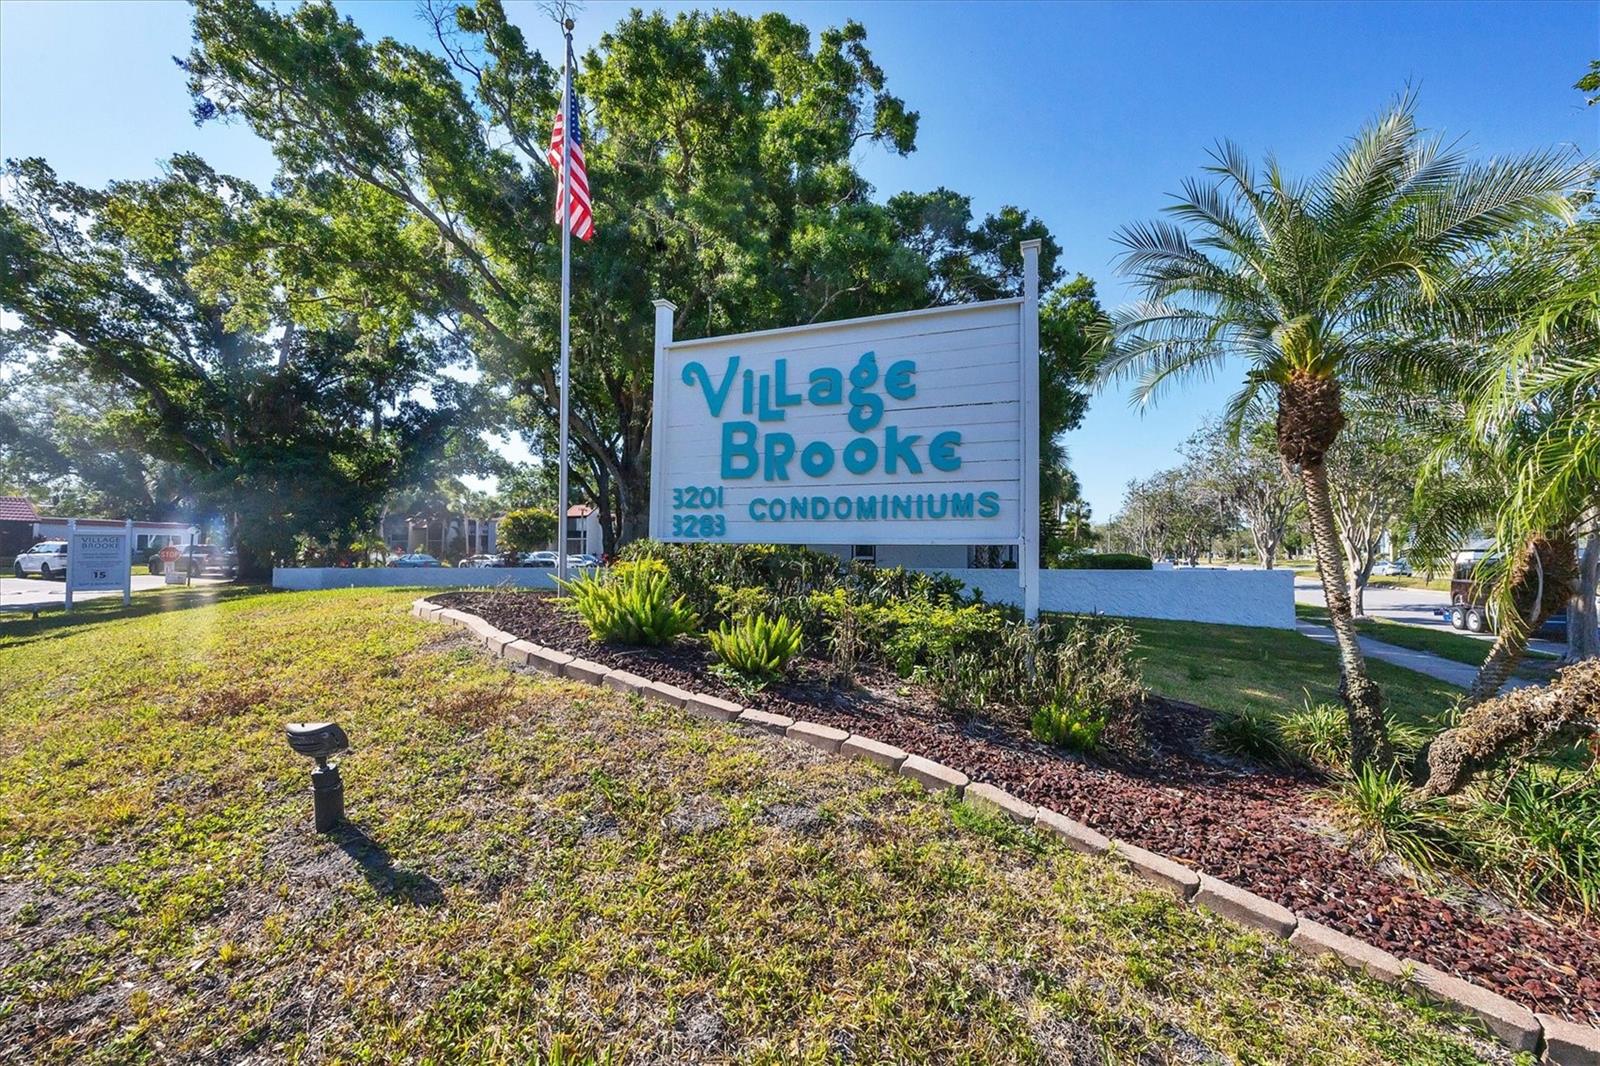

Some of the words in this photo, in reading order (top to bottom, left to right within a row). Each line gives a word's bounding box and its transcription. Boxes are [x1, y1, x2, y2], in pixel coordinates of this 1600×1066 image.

[672, 485, 724, 510] 3201
[748, 491, 1001, 522] CONDOMINIUMS
[672, 514, 727, 538] 3283
[94, 571, 106, 579] 15
